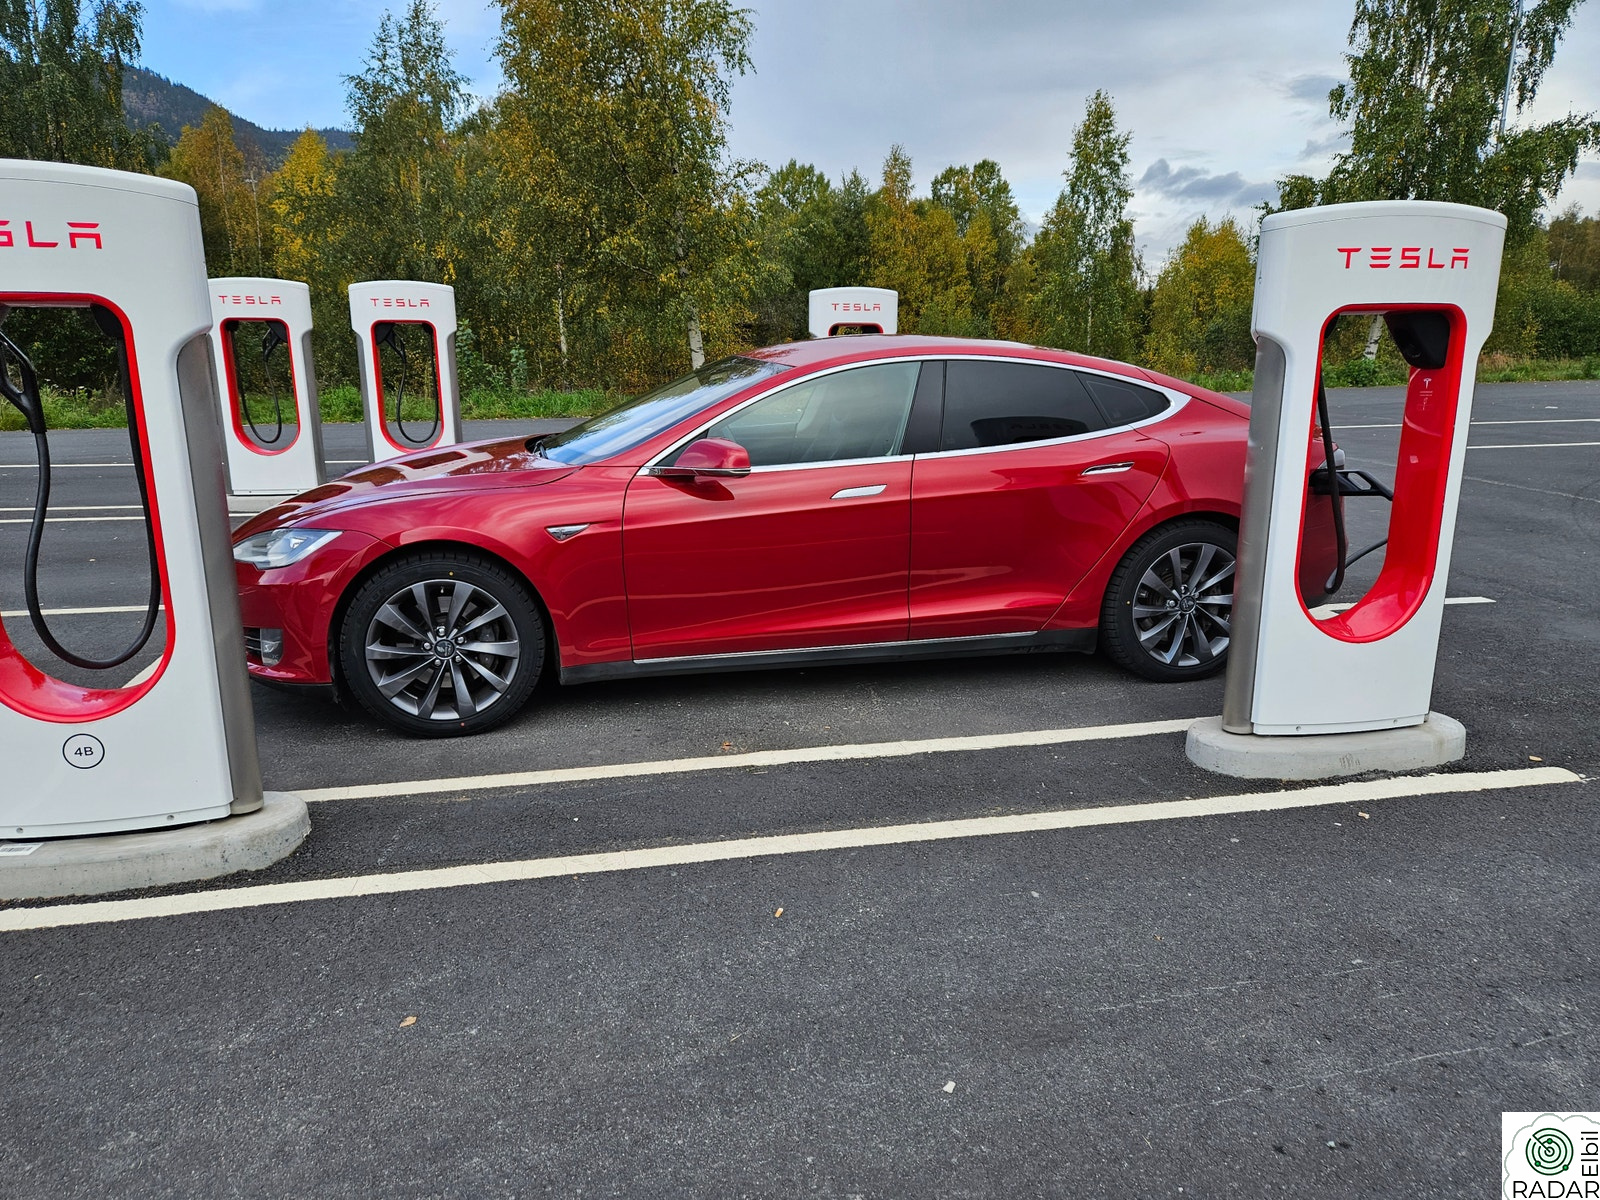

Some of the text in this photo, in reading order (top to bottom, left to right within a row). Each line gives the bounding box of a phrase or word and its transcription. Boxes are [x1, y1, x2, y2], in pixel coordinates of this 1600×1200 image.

[1336, 246, 1470, 269] TESLA
[218, 295, 281, 305] TESLA
[370, 297, 430, 308] TESLA
[832, 303, 881, 311] TESLA
[74, 746, 94, 757] 4B
